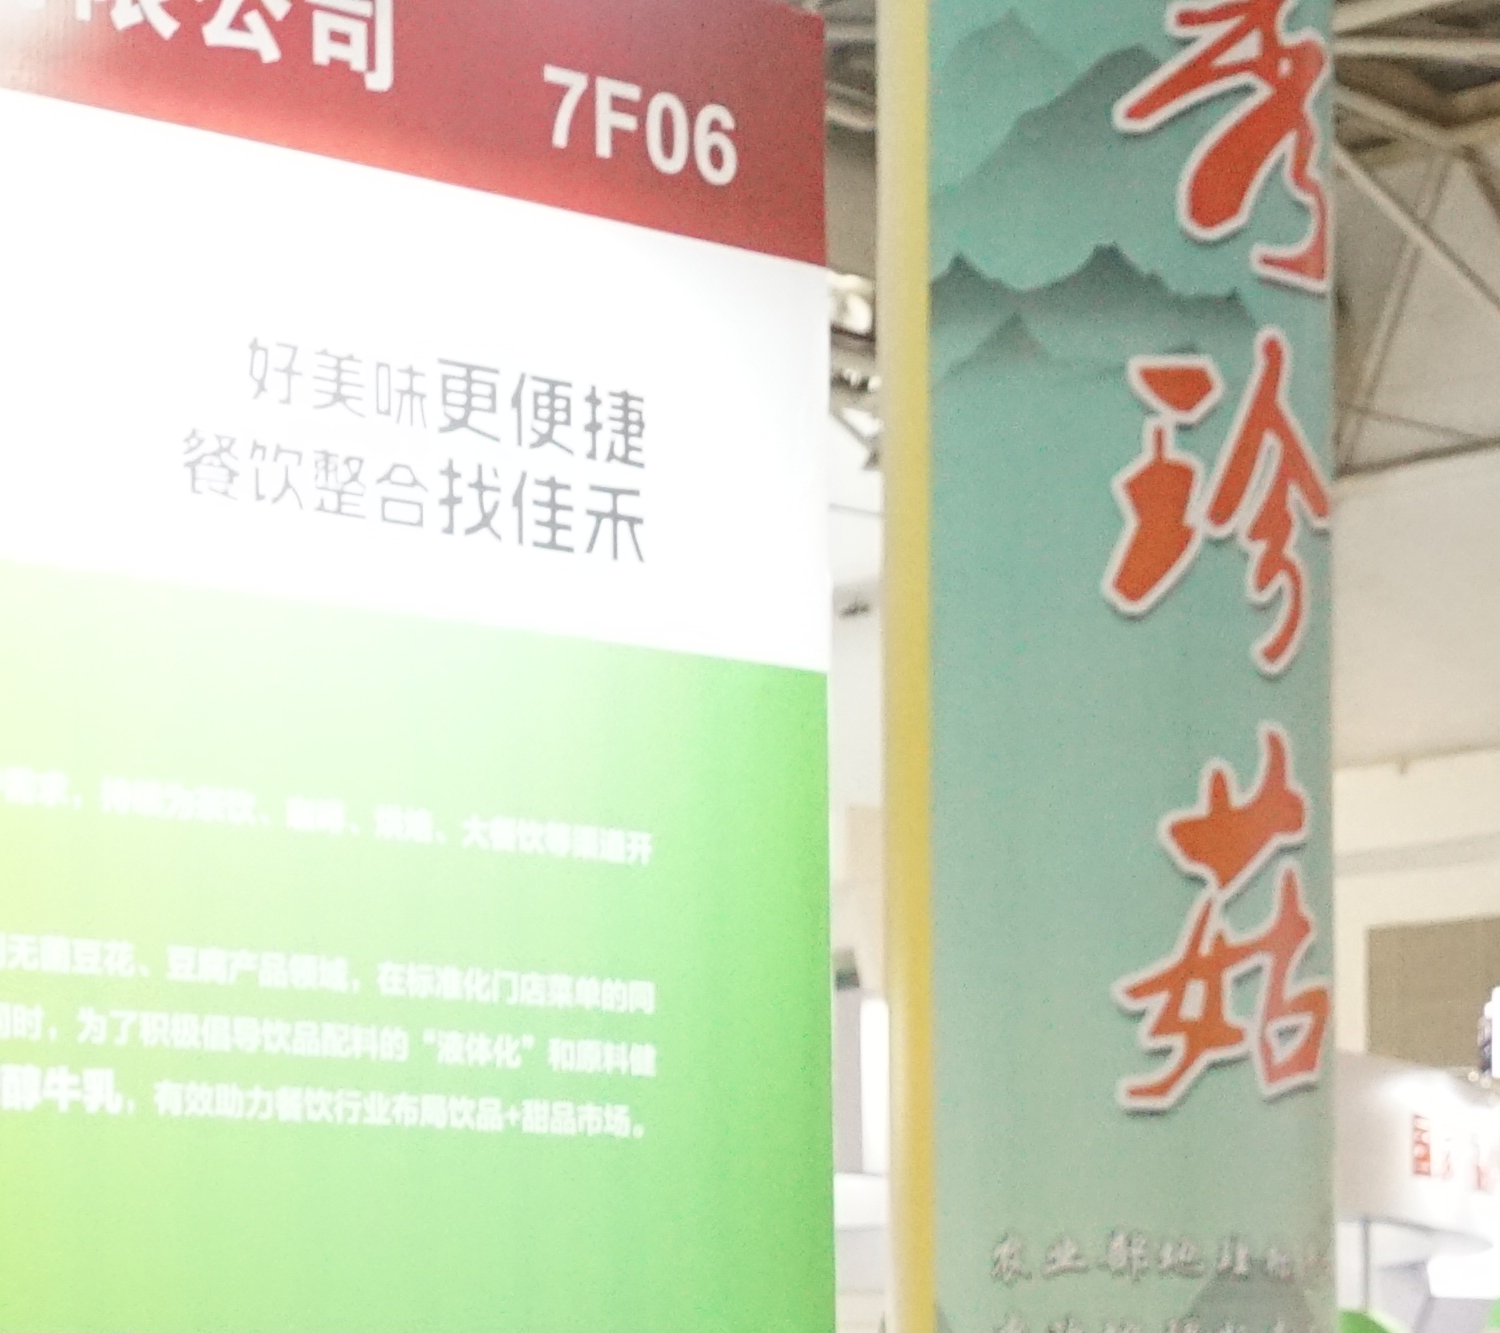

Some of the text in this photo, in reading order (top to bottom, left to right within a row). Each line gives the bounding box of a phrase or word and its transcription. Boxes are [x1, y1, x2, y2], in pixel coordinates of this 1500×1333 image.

[542, 64, 738, 188] 7F06
[247, 335, 647, 470] 好美味更便捷
[182, 428, 645, 563] 餐饮整合找佳禾
